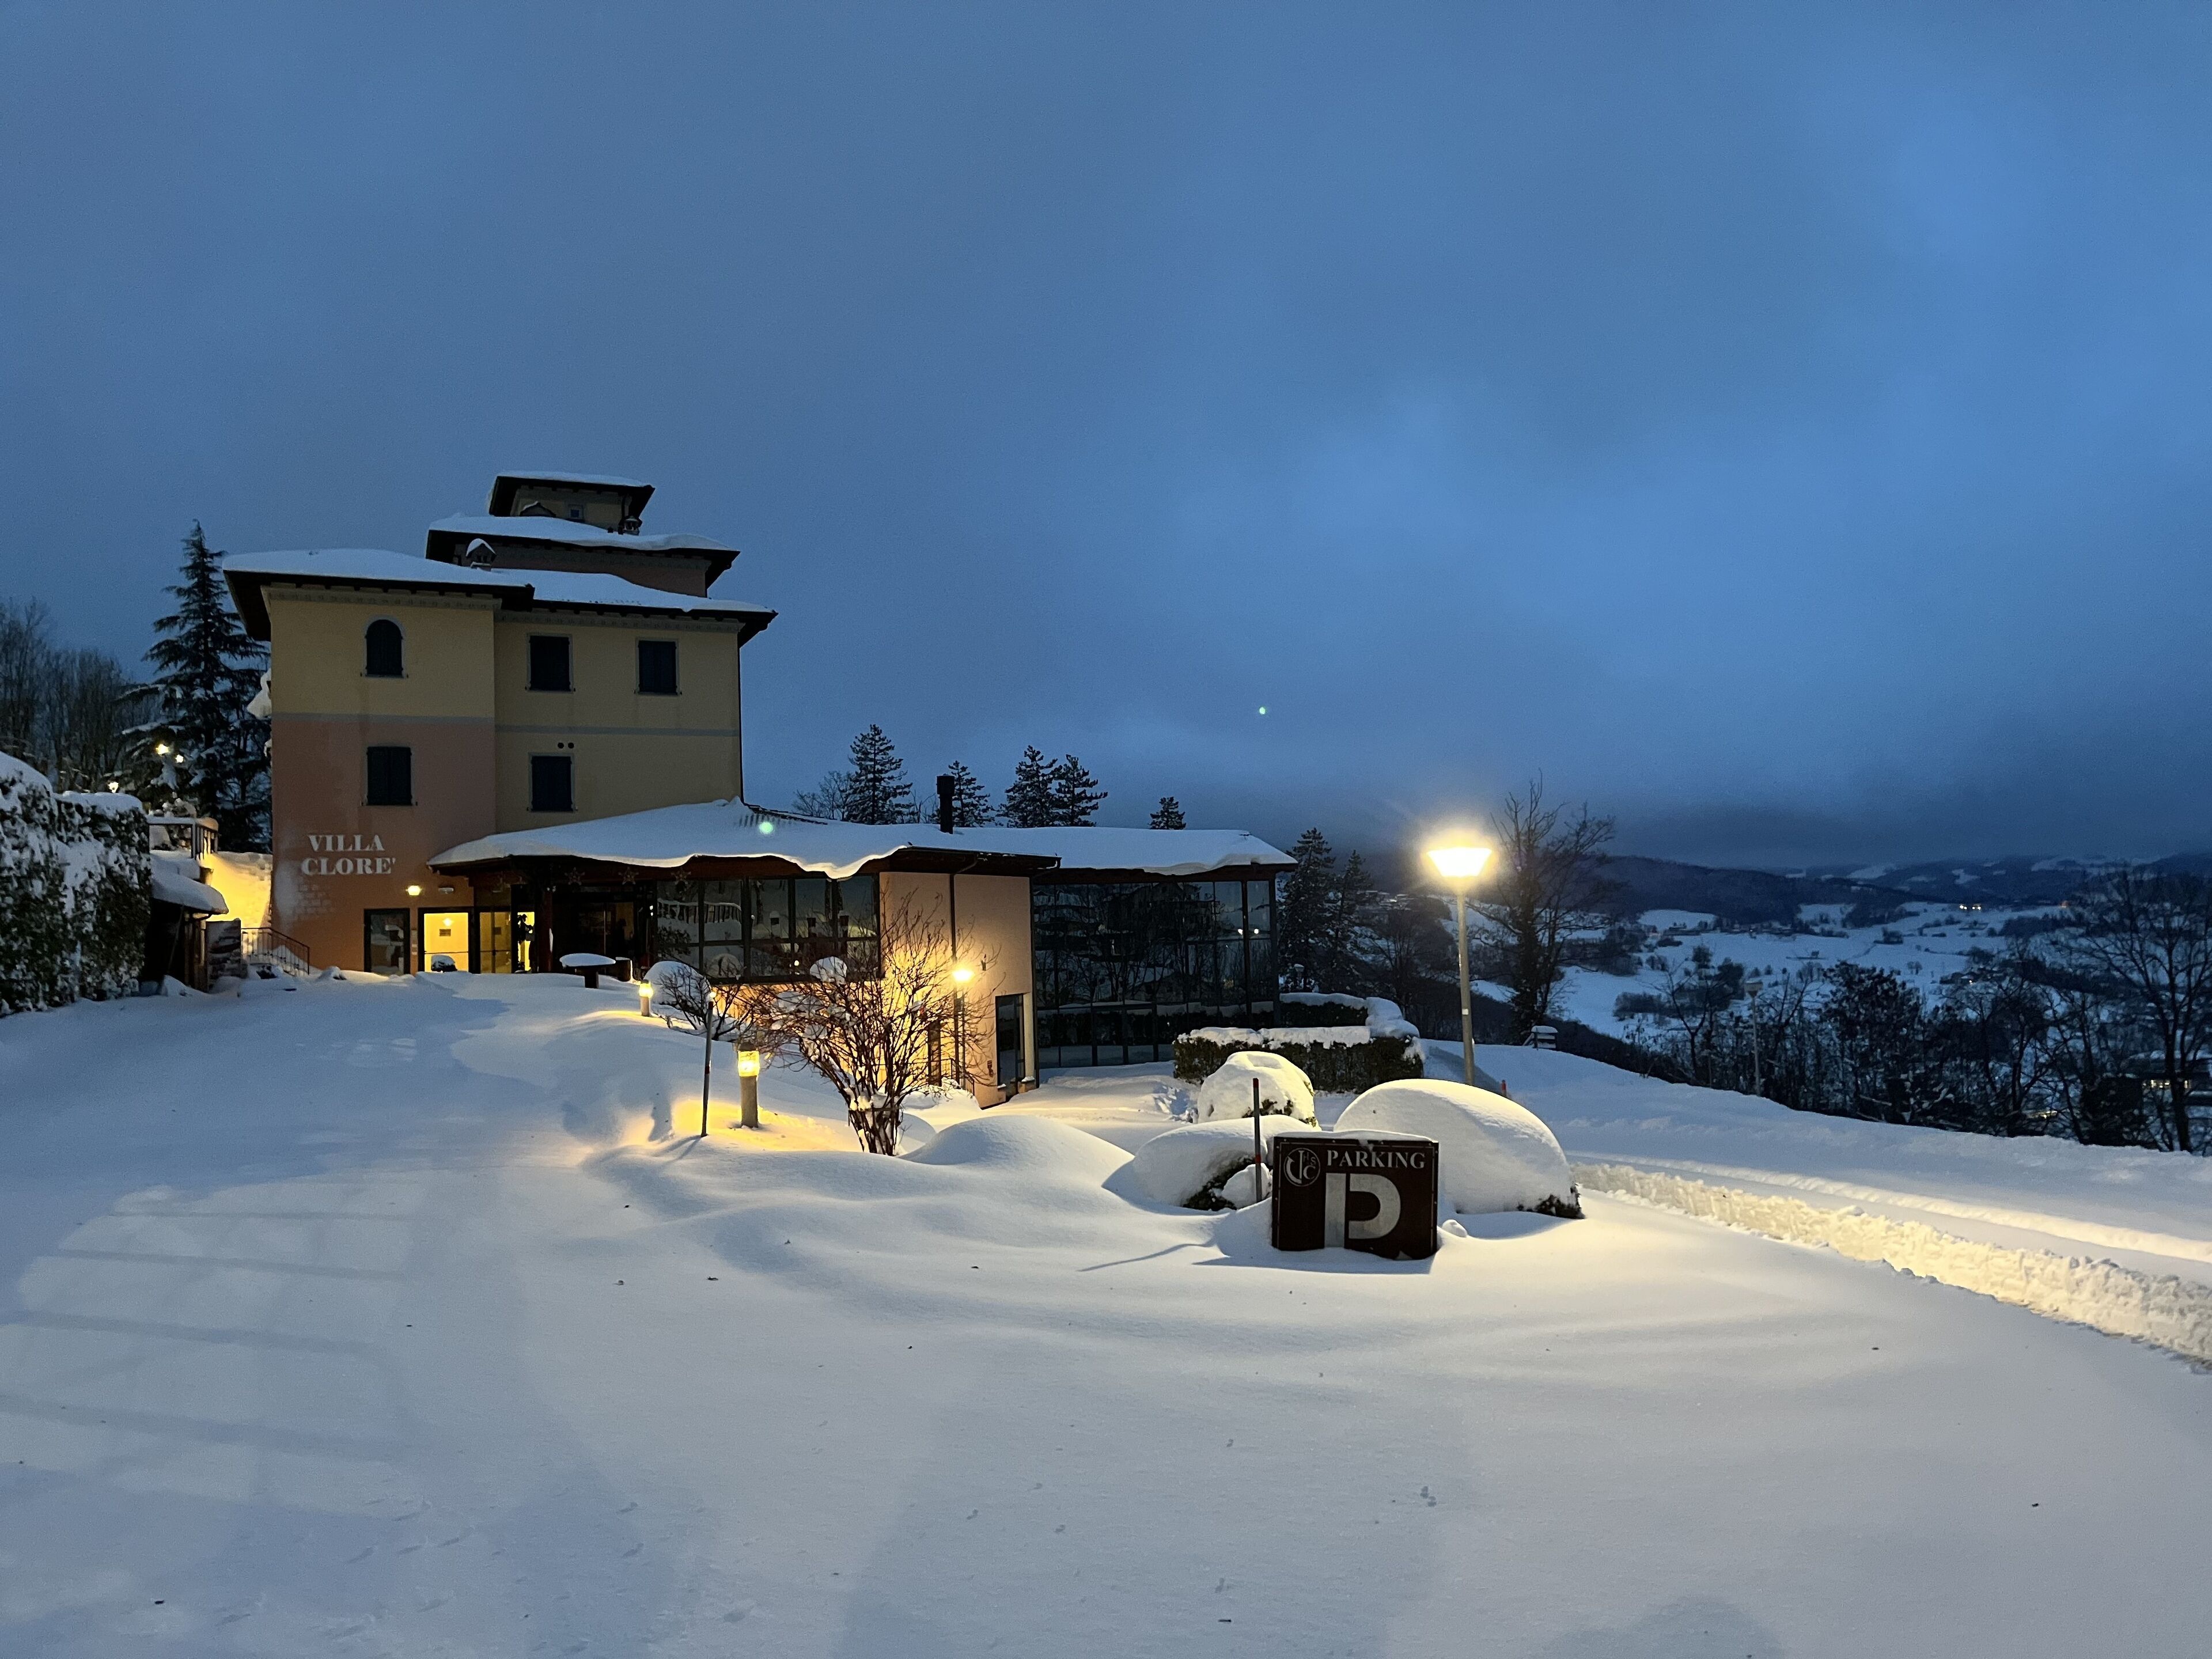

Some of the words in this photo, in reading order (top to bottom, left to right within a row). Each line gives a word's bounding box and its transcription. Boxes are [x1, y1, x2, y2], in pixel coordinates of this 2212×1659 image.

[308, 834, 385, 852] VILLA
[1327, 1150, 1425, 1169] PARKING
[1324, 1172, 1401, 1248] P
